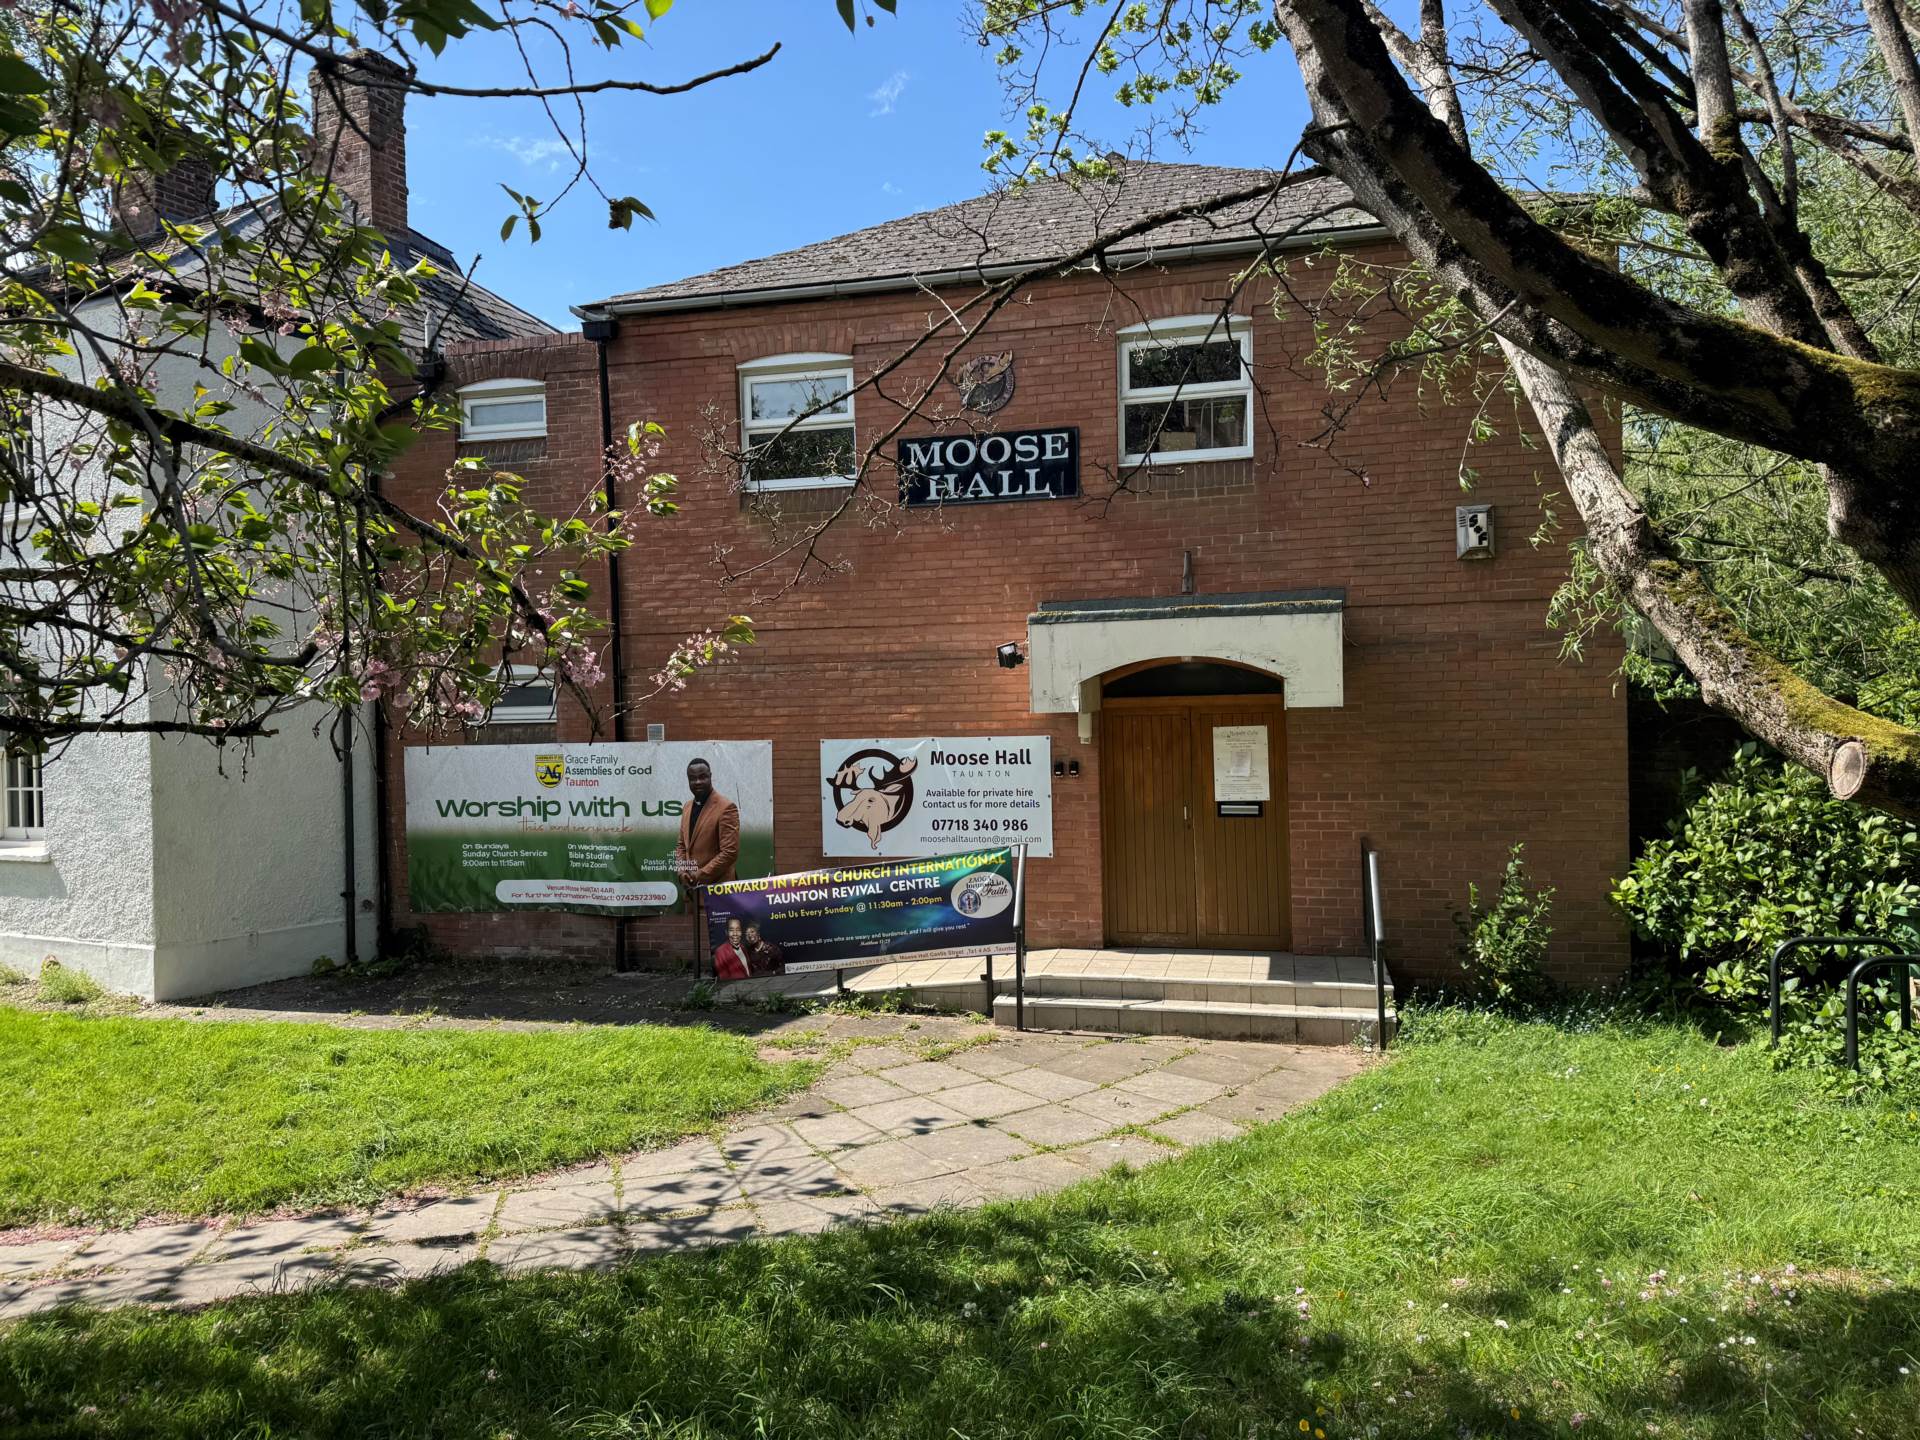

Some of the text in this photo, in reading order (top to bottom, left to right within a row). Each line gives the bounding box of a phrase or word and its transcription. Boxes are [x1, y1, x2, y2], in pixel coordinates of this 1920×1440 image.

[906, 432, 1069, 469] MOOSE
[926, 468, 1054, 501] HALL
[564, 755, 589, 765] Grace
[590, 754, 618, 766] Family
[930, 749, 1031, 766] Moose Hall
[565, 765, 652, 776] Assemblies of God
[952, 770, 1011, 778] TAUNTON
[565, 777, 599, 787] Taunton
[926, 788, 1034, 800] Available for private hire
[435, 796, 683, 822] Worship with us
[922, 800, 1041, 809] Contact us for more details
[931, 819, 1028, 832] 07718 340 986
[920, 834, 1042, 846] moosehalltaunton@gmail.com
[474, 843, 509, 851] Sundays
[577, 844, 627, 853] Wednesdays
[462, 849, 548, 859] Sunday Church Service
[568, 851, 614, 861] Bible Studies
[462, 859, 490, 867] 9:00am
[570, 860, 581, 868] 7pm
[589, 861, 608, 869] Zoom
[707, 853, 1006, 896] FORWARD IN FAITH CHURCH INTERNATIONAL
[765, 876, 941, 906] TAUNTON REVIVAL CENTRE
[980, 884, 1008, 897] Faith
[770, 912, 786, 920] Join
[788, 910, 799, 918] Us
[800, 908, 822, 918] Every
[824, 905, 854, 915] Sunday
[856, 902, 866, 913] @
[868, 900, 904, 910] 11:30am
[911, 896, 943, 906] 2:00pm
